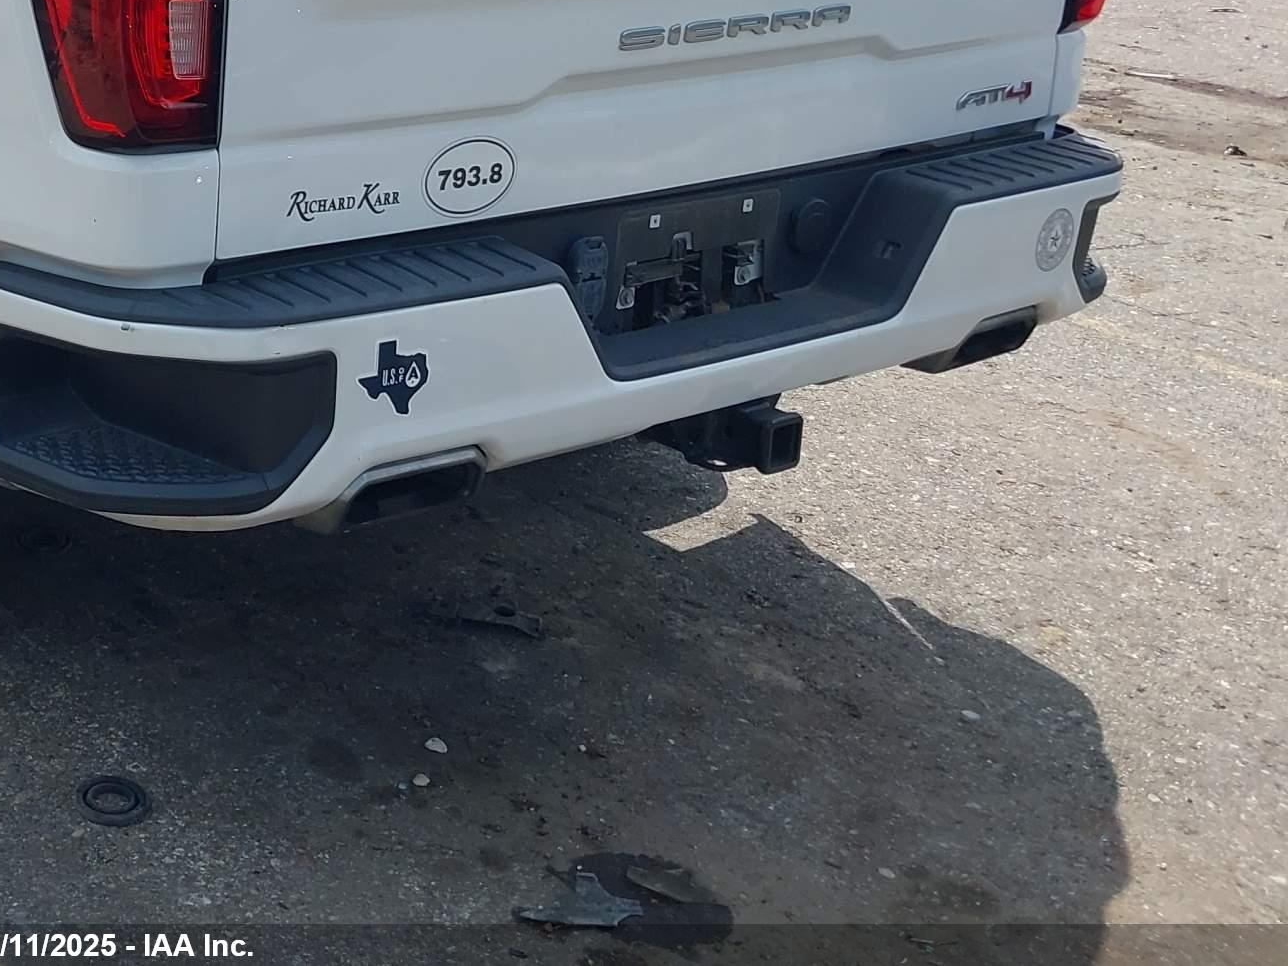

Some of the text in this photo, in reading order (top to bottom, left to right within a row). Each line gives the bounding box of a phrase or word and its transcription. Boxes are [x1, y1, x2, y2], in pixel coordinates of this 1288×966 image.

[619, 2, 851, 52] SIERRA
[955, 79, 1033, 111] AT4
[437, 162, 503, 191] 793.8
